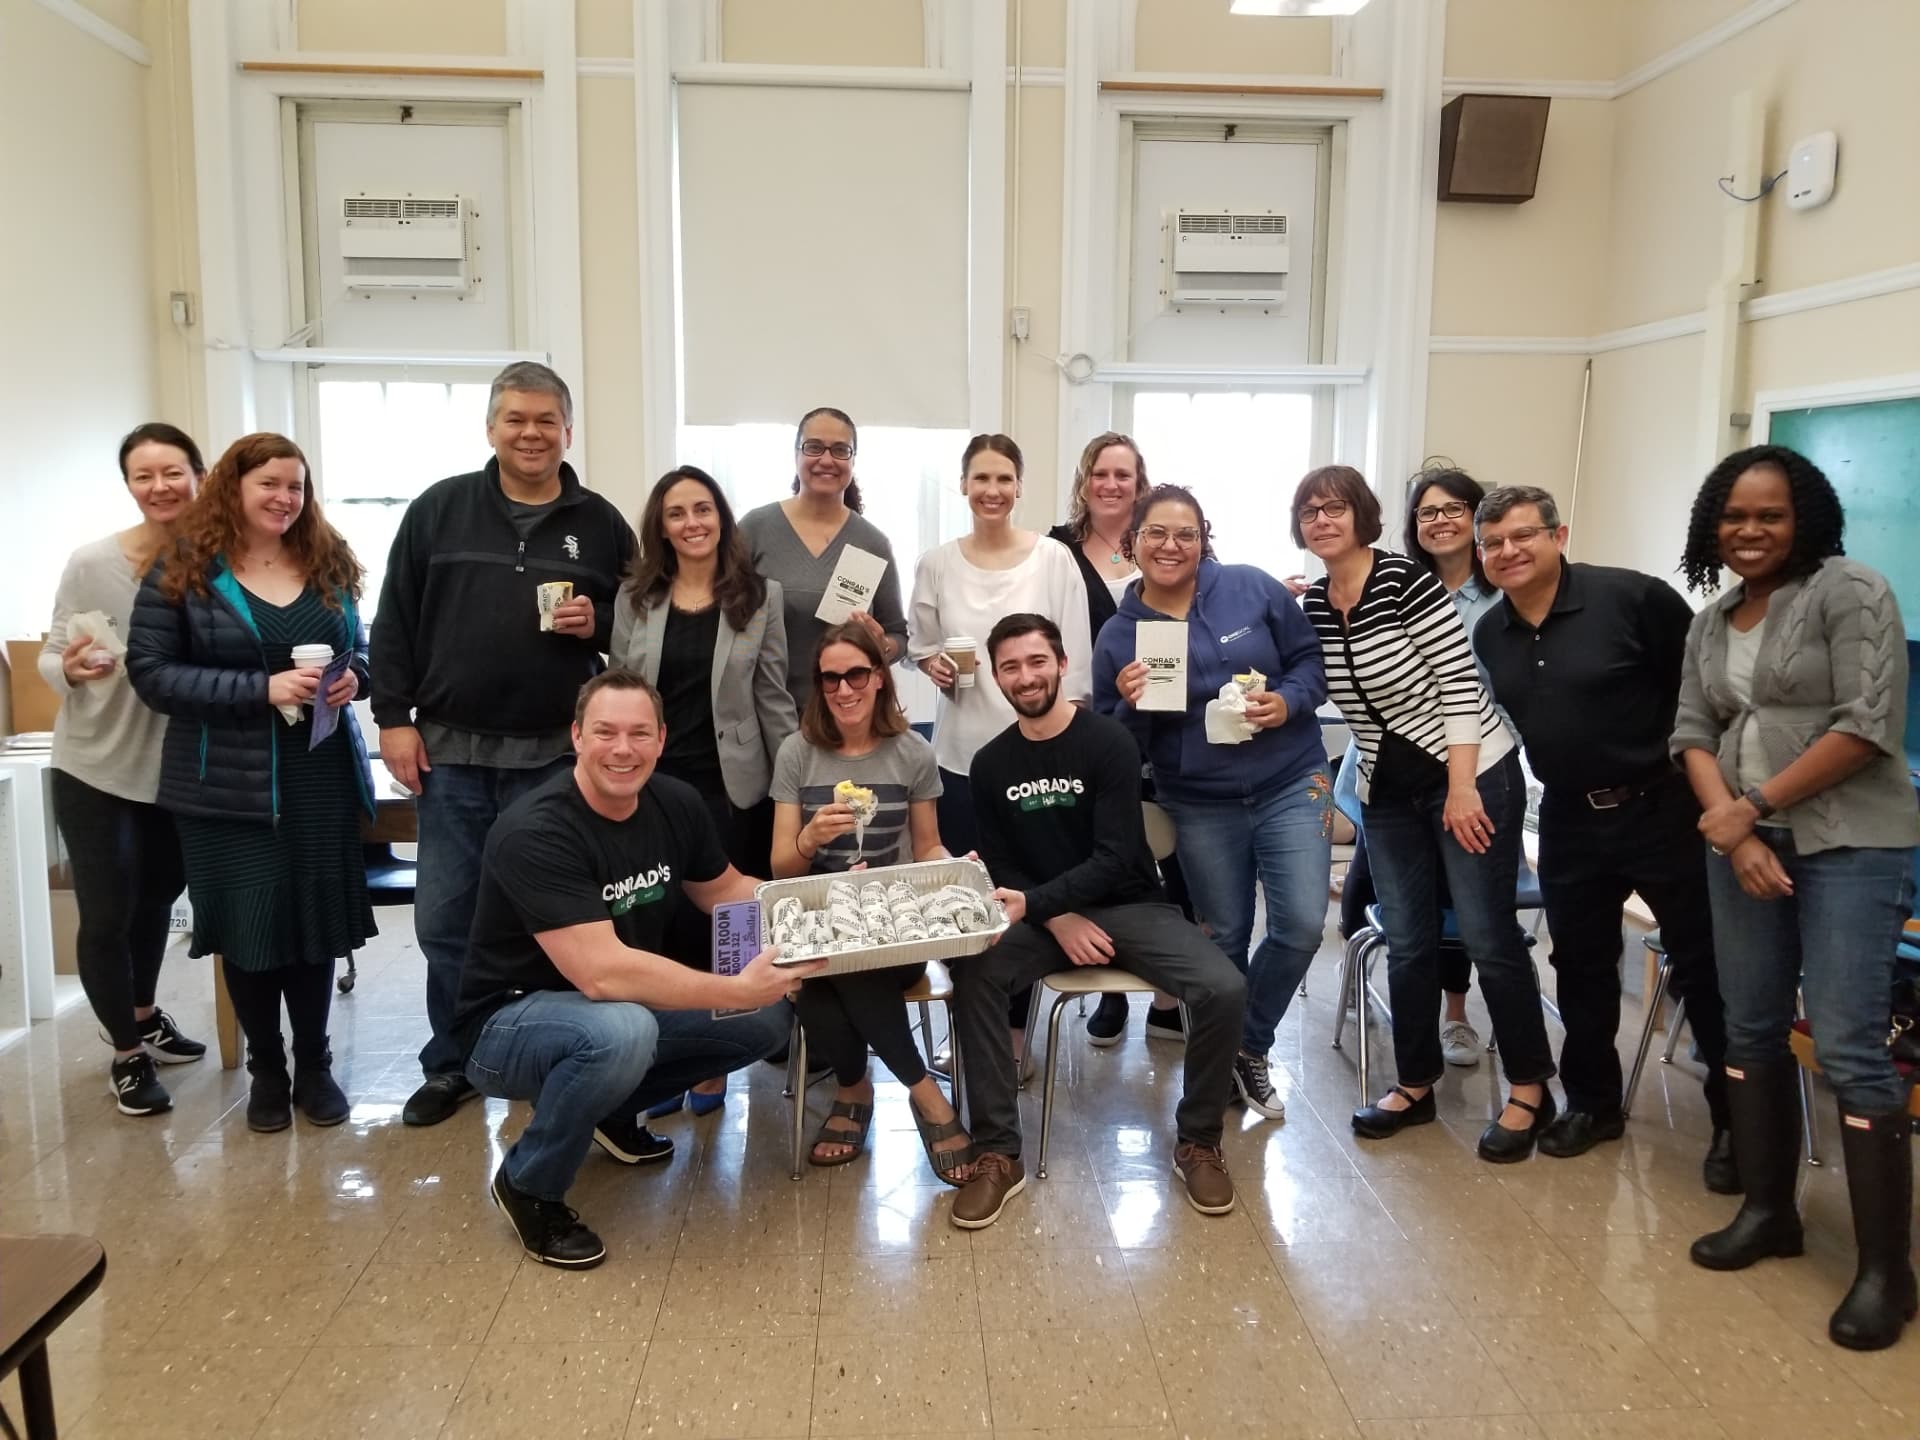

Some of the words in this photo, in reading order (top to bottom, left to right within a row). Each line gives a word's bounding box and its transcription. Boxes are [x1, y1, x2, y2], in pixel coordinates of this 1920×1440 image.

[1006, 775, 1085, 801] CONRAD'S
[602, 862, 671, 901] CONRAD'S
[718, 909, 731, 947] ROOM
[732, 932, 740, 948] 322
[718, 950, 731, 977] ENT
